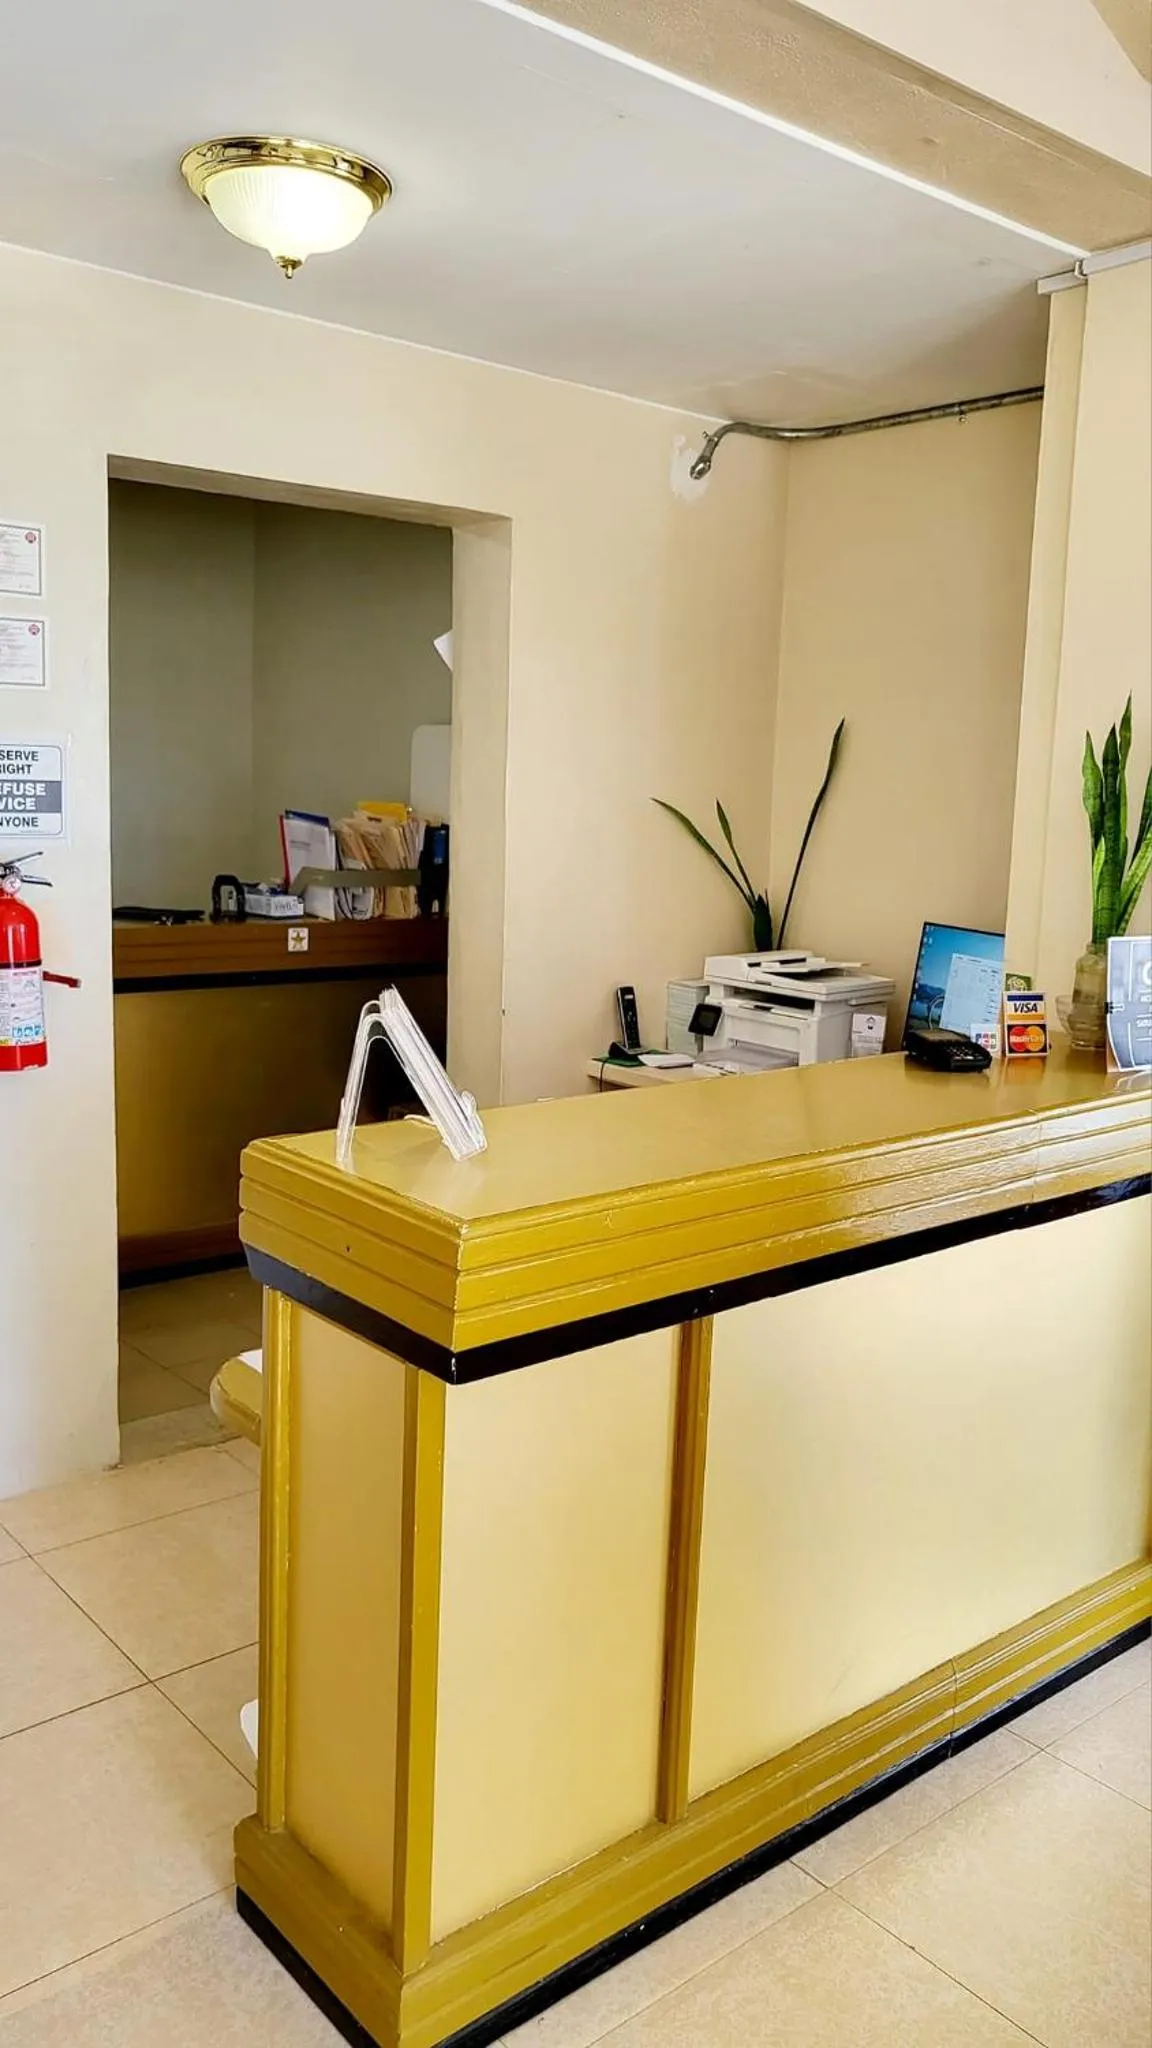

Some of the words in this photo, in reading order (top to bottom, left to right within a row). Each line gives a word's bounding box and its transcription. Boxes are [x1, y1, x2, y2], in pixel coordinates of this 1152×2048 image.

[0, 763, 33, 775] IGHT
[0, 782, 46, 796] FUSE
[1013, 1003, 1038, 1014] VISA
